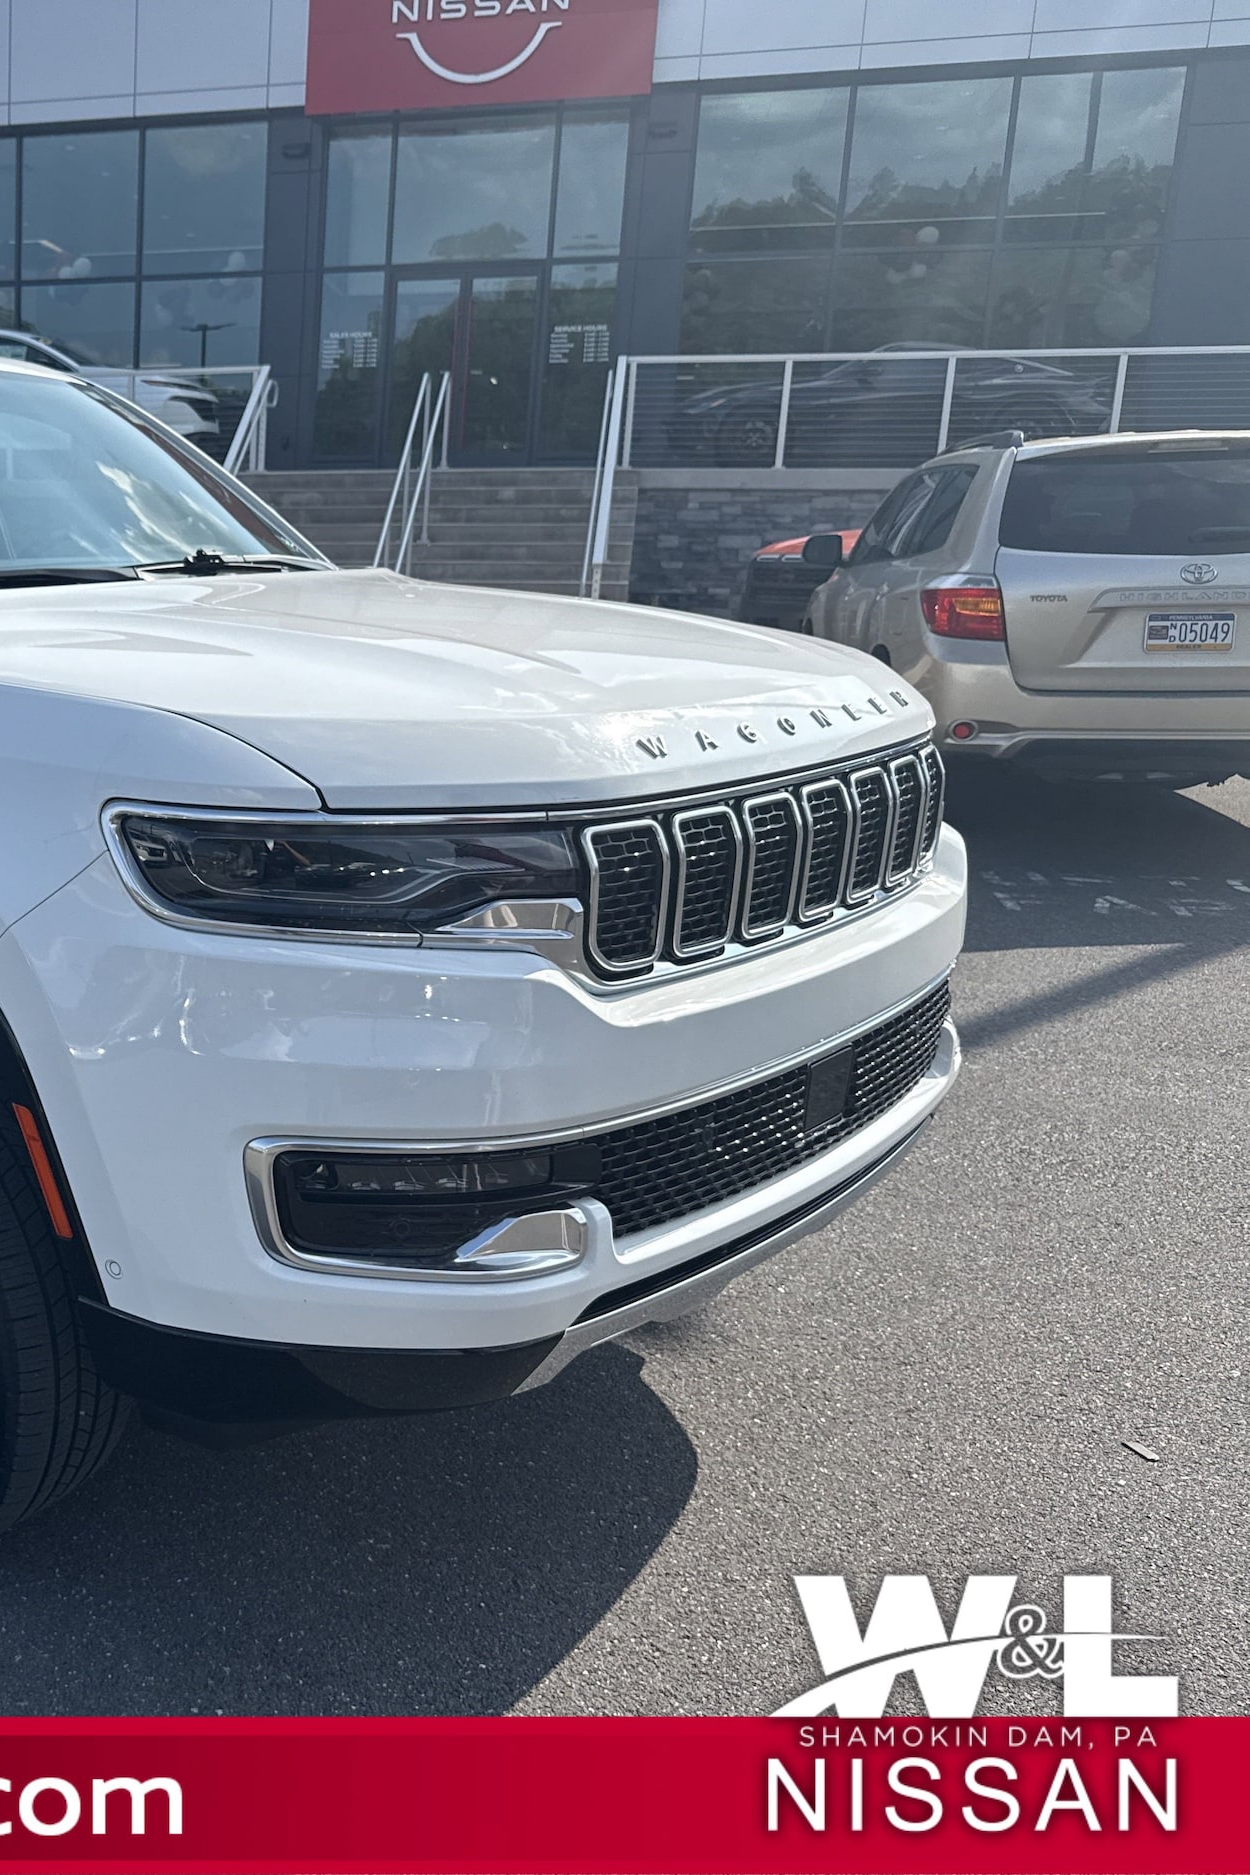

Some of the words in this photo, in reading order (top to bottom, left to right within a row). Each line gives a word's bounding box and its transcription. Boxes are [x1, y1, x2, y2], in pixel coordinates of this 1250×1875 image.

[1029, 594, 1069, 603] TOYOTA
[1119, 591, 1250, 602] HIGHLAND
[636, 690, 910, 760] WAGONEER
